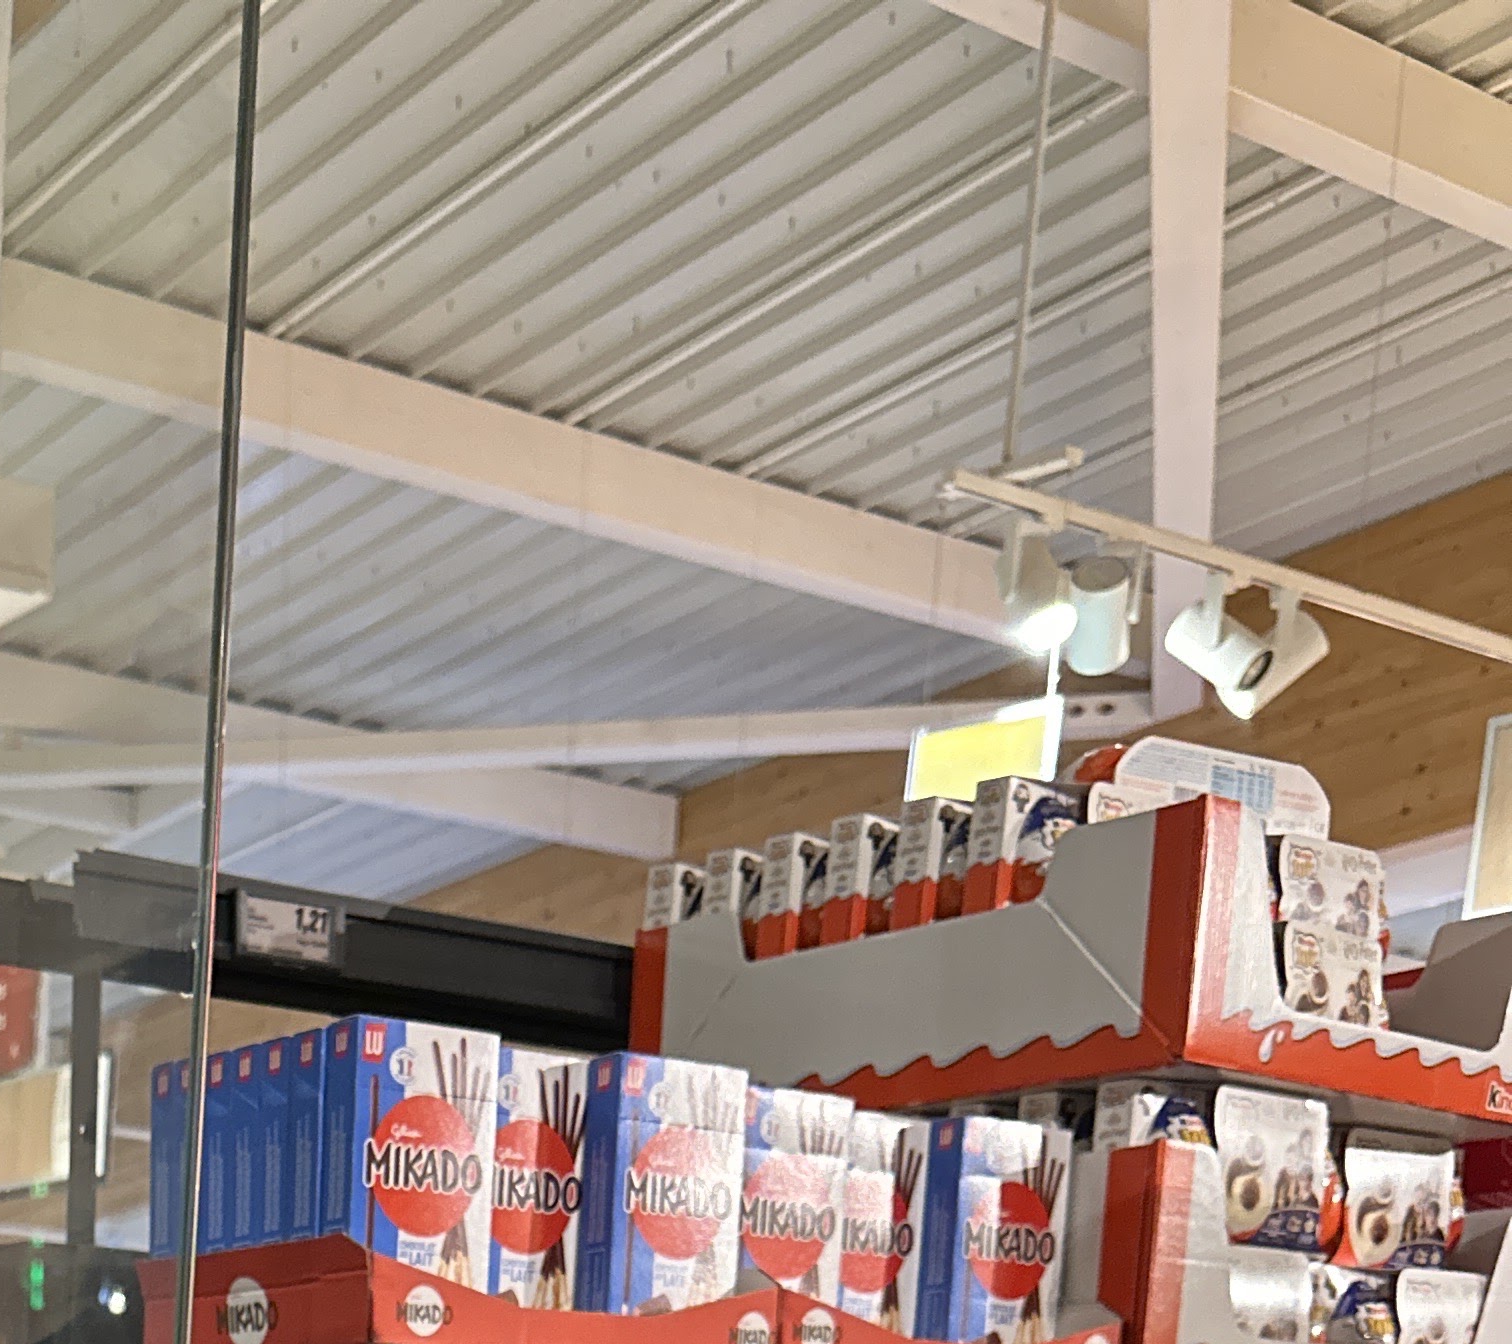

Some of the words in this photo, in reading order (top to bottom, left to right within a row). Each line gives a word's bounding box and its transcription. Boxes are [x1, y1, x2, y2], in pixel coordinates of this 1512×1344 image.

[364, 1139, 482, 1195] MIKADO
[624, 1167, 732, 1220] MIKADO
[739, 1197, 836, 1242] MIKADO
[841, 1217, 914, 1256] IKADO
[963, 1218, 1056, 1265] MIKADO
[216, 1301, 278, 1335] MIKADO
[396, 1302, 454, 1326] MIKADO
